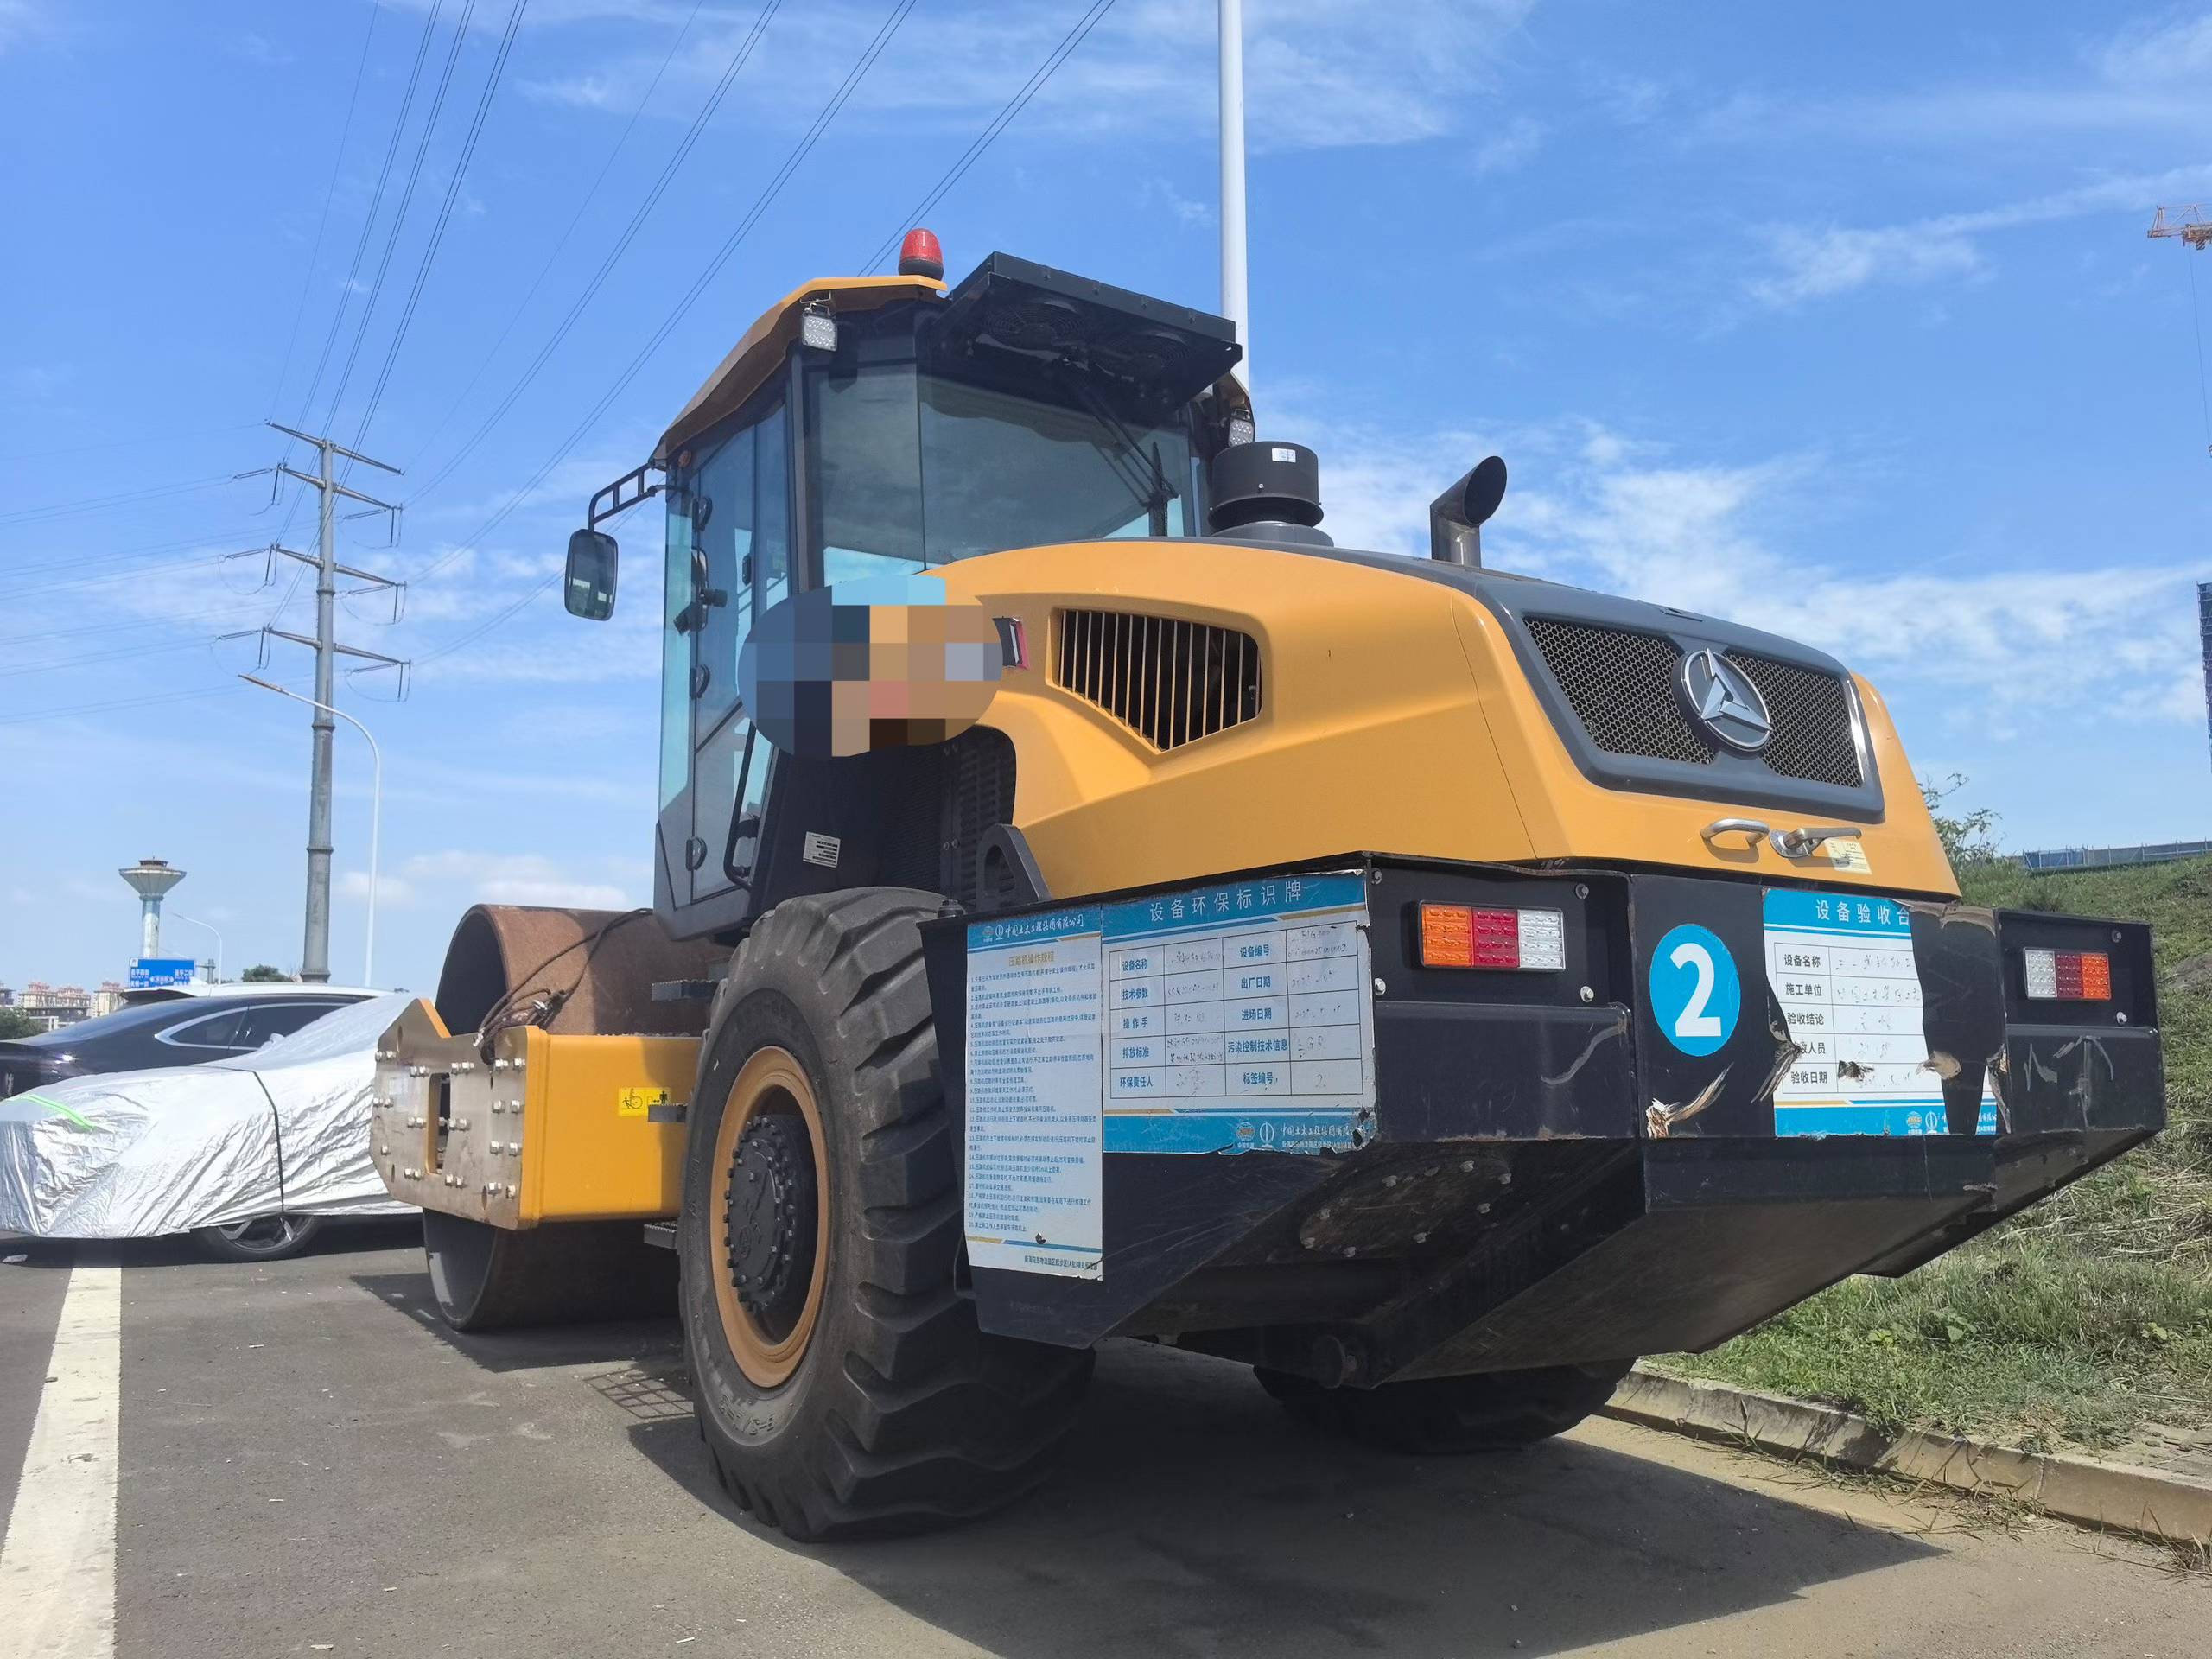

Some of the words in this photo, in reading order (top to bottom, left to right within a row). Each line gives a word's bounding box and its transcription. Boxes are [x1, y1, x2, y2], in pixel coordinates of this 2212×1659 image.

[1149, 880, 1301, 922] 设备环保标识牌
[1240, 944, 1270, 958] 设备编号
[1122, 958, 1148, 972] 设备名称
[1783, 954, 1821, 968] 设备名称
[1241, 976, 1271, 989] 出厂日期
[1785, 982, 1822, 996] 施工单位
[1122, 987, 1148, 1001] 技术参数
[1669, 942, 1722, 1038] 2
[1241, 1007, 1272, 1021] 进场日期
[1787, 1012, 1825, 1026] 验收结论
[1123, 1016, 1148, 1029] 操作手
[1122, 1046, 1150, 1059] 排放标准
[1227, 1039, 1288, 1053] 污染控制技术信息
[1120, 1076, 1154, 1089] 环保责任人
[1243, 1071, 1274, 1085] 标签编号
[1790, 1071, 1828, 1084] 验收日期
